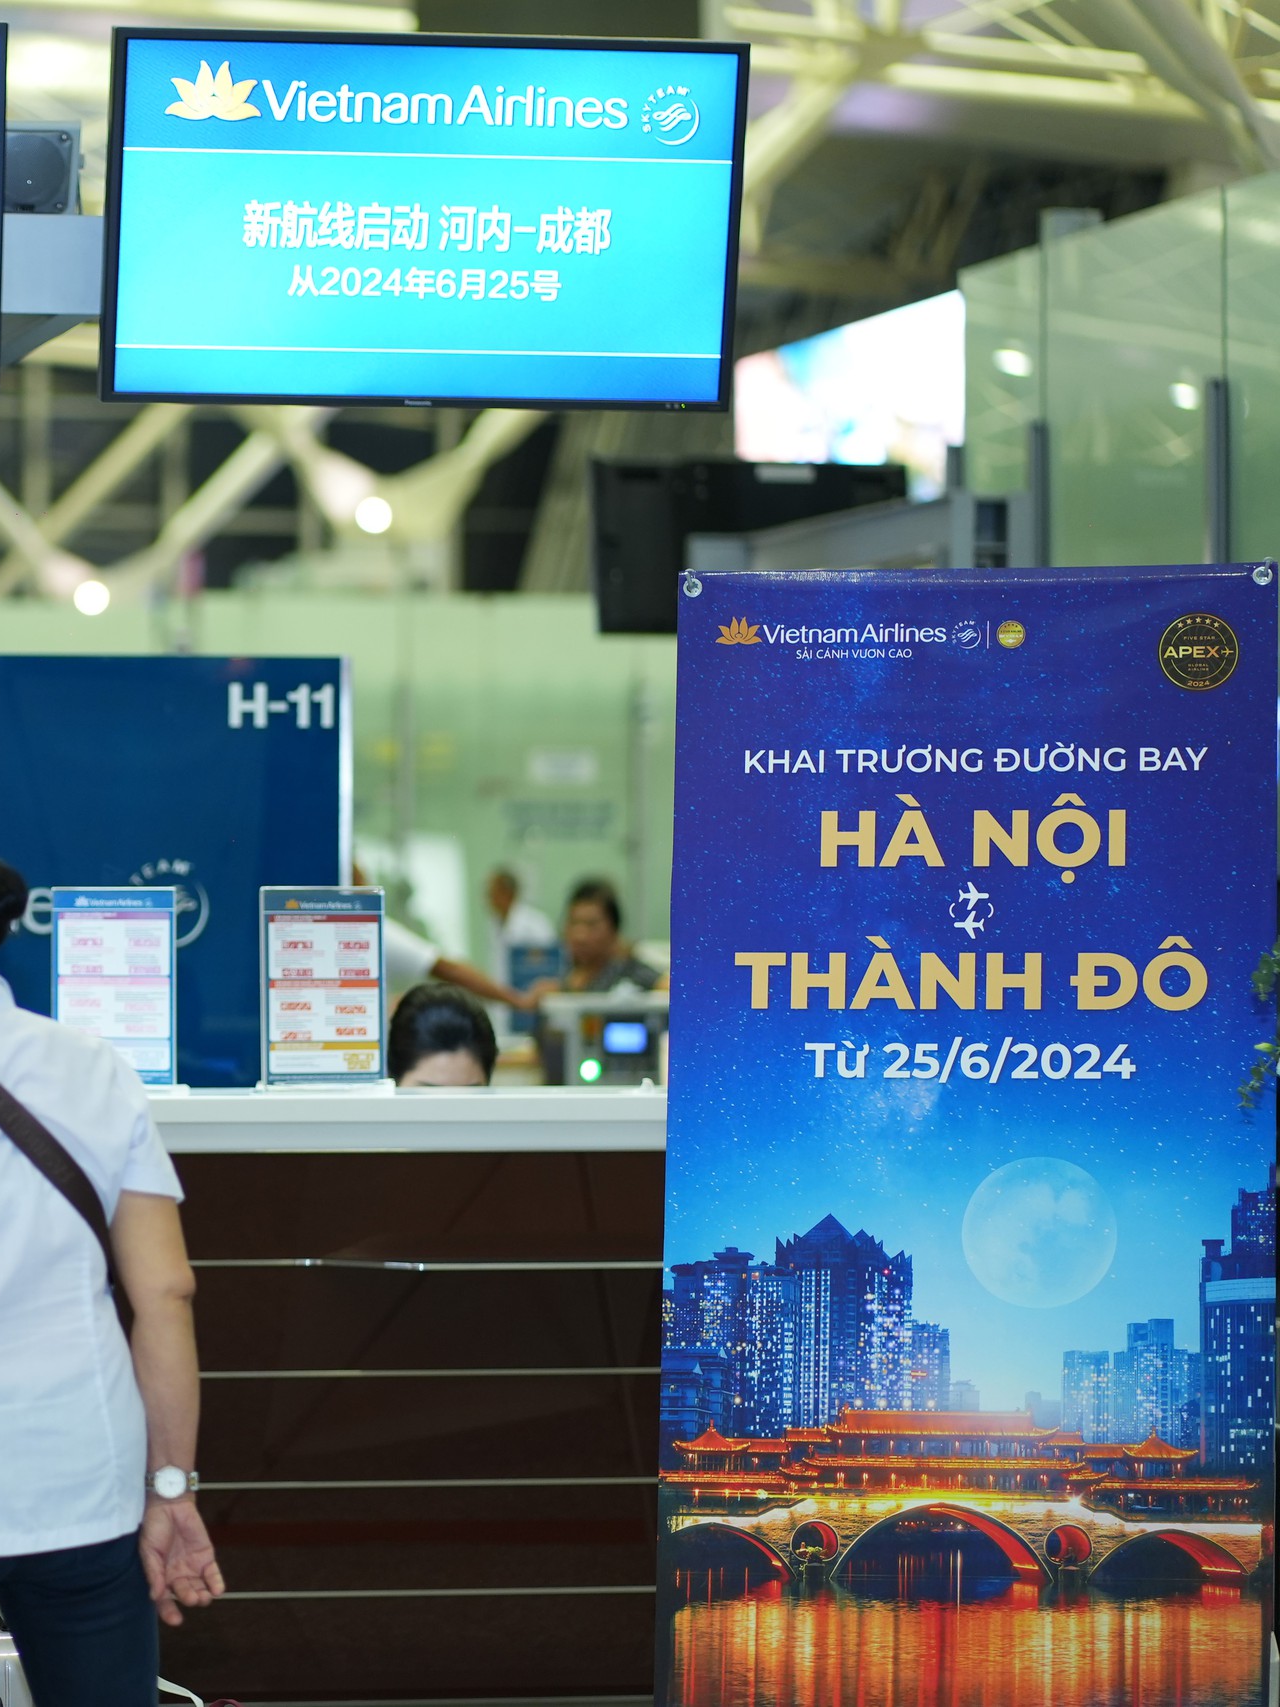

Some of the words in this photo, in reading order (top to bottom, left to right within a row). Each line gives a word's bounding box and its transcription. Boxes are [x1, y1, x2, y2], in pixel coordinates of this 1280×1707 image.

[261, 79, 454, 127] Vietnam
[457, 83, 628, 130] Airlines
[243, 199, 429, 251] 新航线启动
[287, 266, 562, 303] 从2024年6月25号
[762, 624, 859, 645] Vietnam
[860, 622, 947, 644] Airlines
[796, 646, 813, 660] SẢI
[816, 647, 849, 659] CÁNH
[888, 648, 913, 659] CAO
[227, 681, 335, 730] H-11
[743, 749, 826, 774] KHAI
[836, 745, 983, 773] TRƯƠNG
[994, 742, 1127, 773] ĐƯỜNG
[1139, 747, 1208, 772] BAY
[820, 793, 945, 867] HÀ
[972, 792, 1127, 884] NỘI
[734, 935, 1043, 1011] THÀNH
[1069, 935, 1209, 1011] ĐÔ
[804, 1041, 870, 1080] Từ
[882, 1036, 1136, 1084] 25/6/2024
